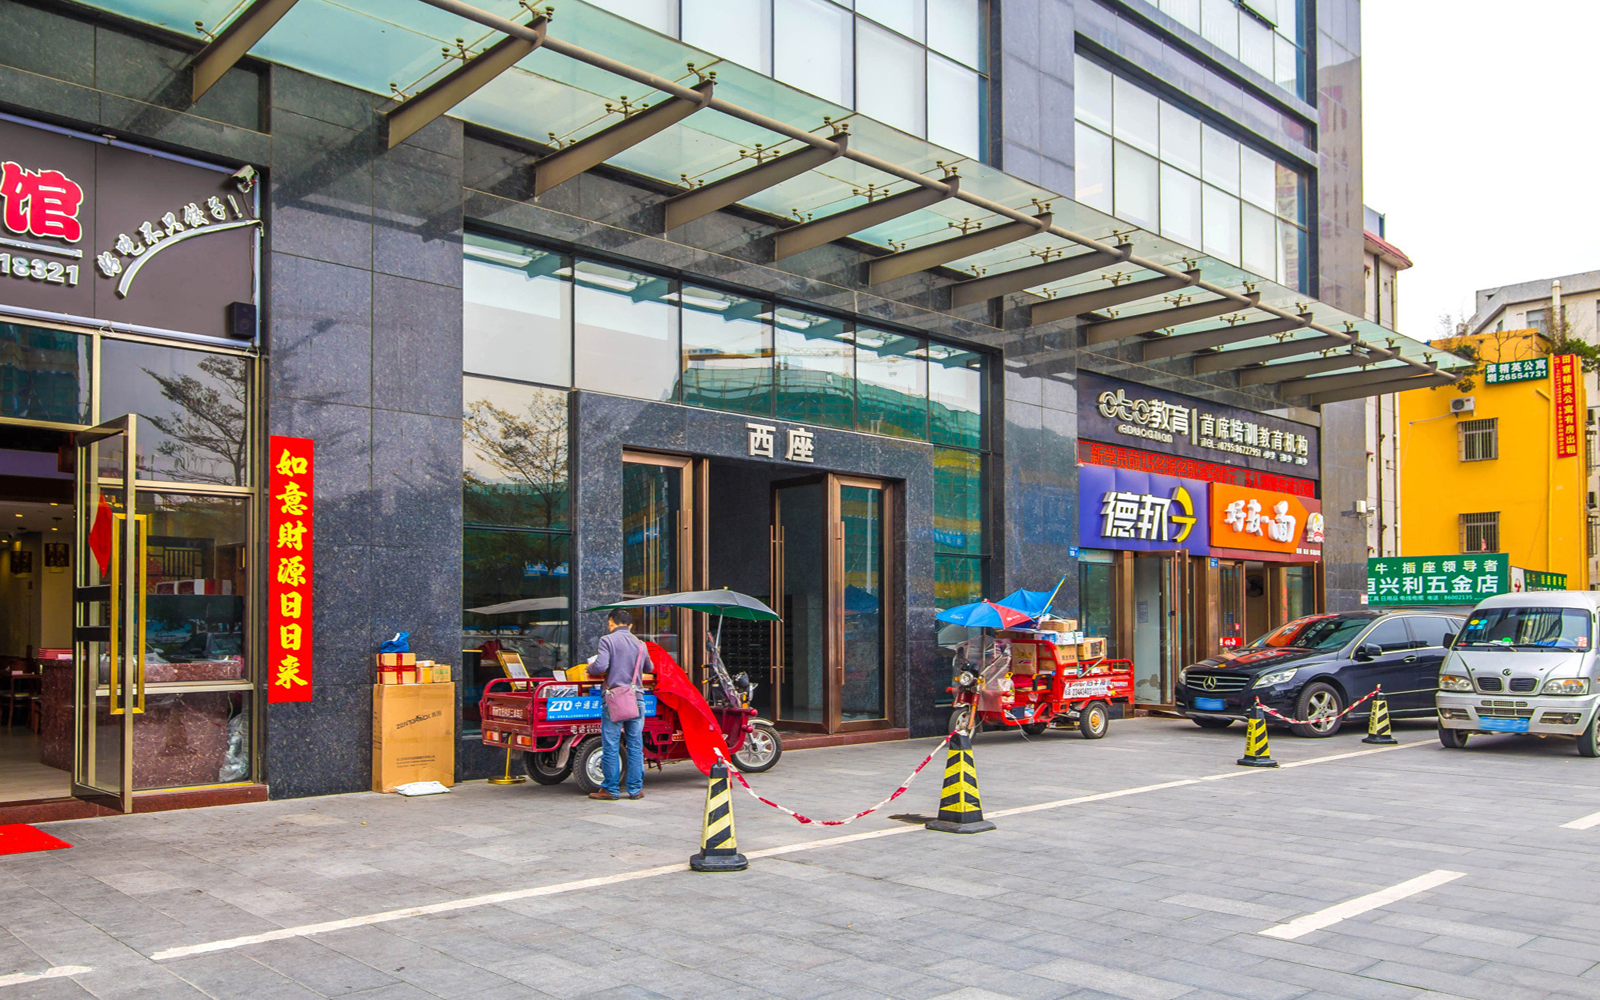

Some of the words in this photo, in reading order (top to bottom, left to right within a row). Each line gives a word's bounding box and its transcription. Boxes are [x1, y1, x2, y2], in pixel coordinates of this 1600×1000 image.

[0, 161, 84, 243] 馆
[1499, 359, 1547, 374] 精英公寓
[1499, 370, 1547, 381] 26554731
[745, 422, 815, 463] 西座
[1199, 413, 1309, 456] 首席培训教育机构
[1100, 491, 1171, 541] 德邦
[548, 700, 573, 712] ZTO
[574, 699, 602, 710] 中通速
